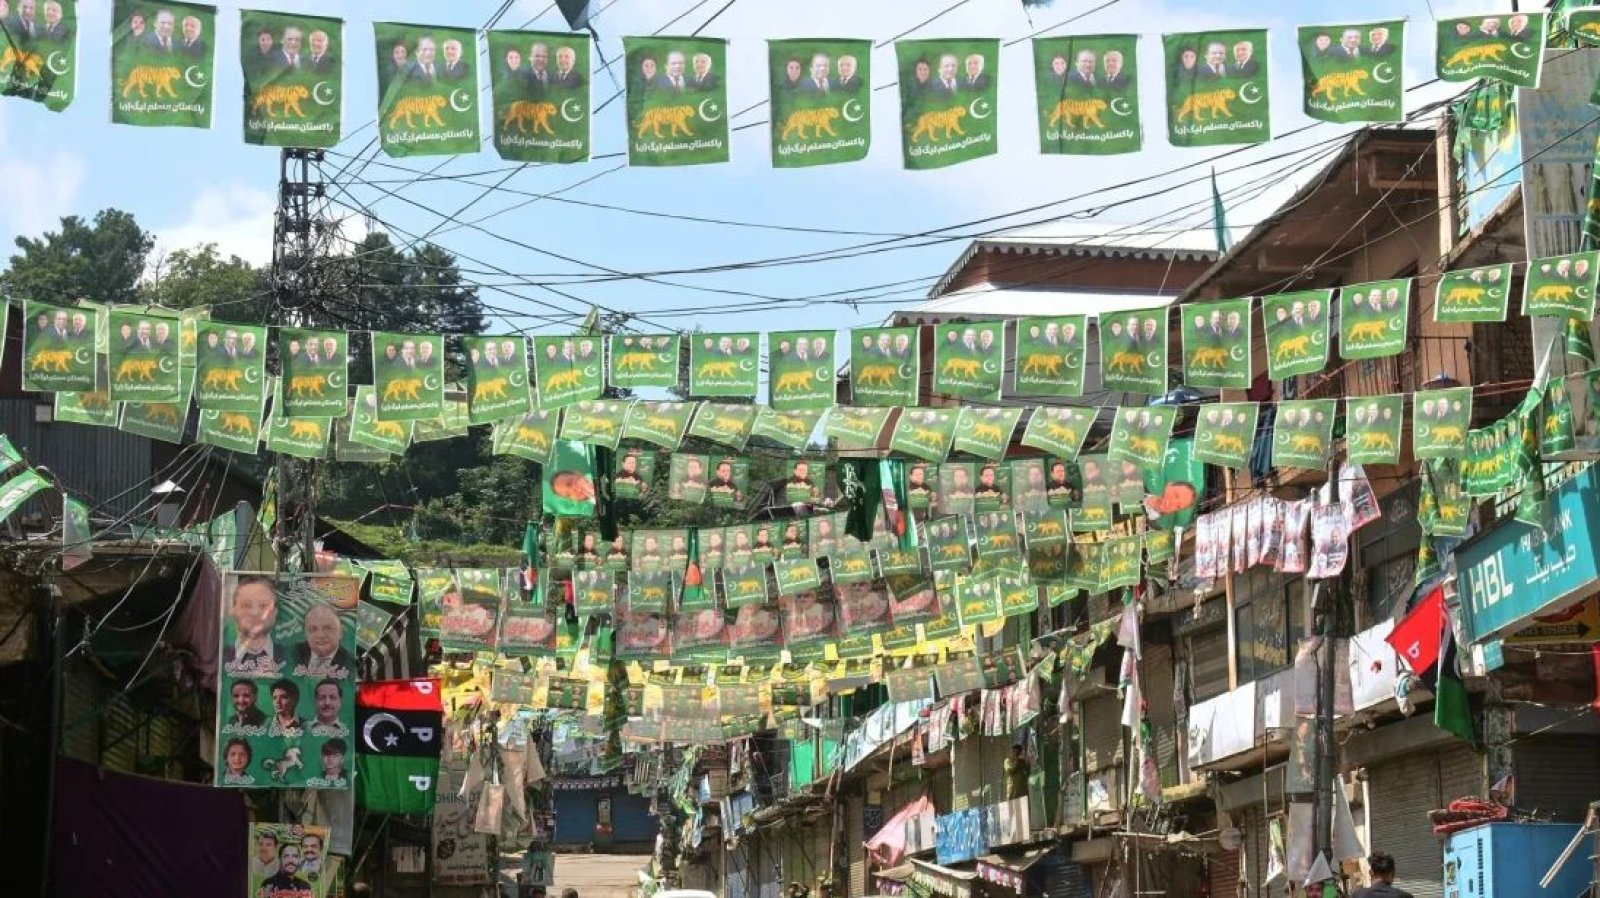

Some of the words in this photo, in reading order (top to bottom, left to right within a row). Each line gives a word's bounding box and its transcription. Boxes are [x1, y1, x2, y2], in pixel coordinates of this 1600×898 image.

[1469, 549, 1514, 614] HBL
[1408, 640, 1420, 658] P
[410, 681, 433, 695] P
[411, 727, 433, 742] P
[408, 775, 431, 791] P
